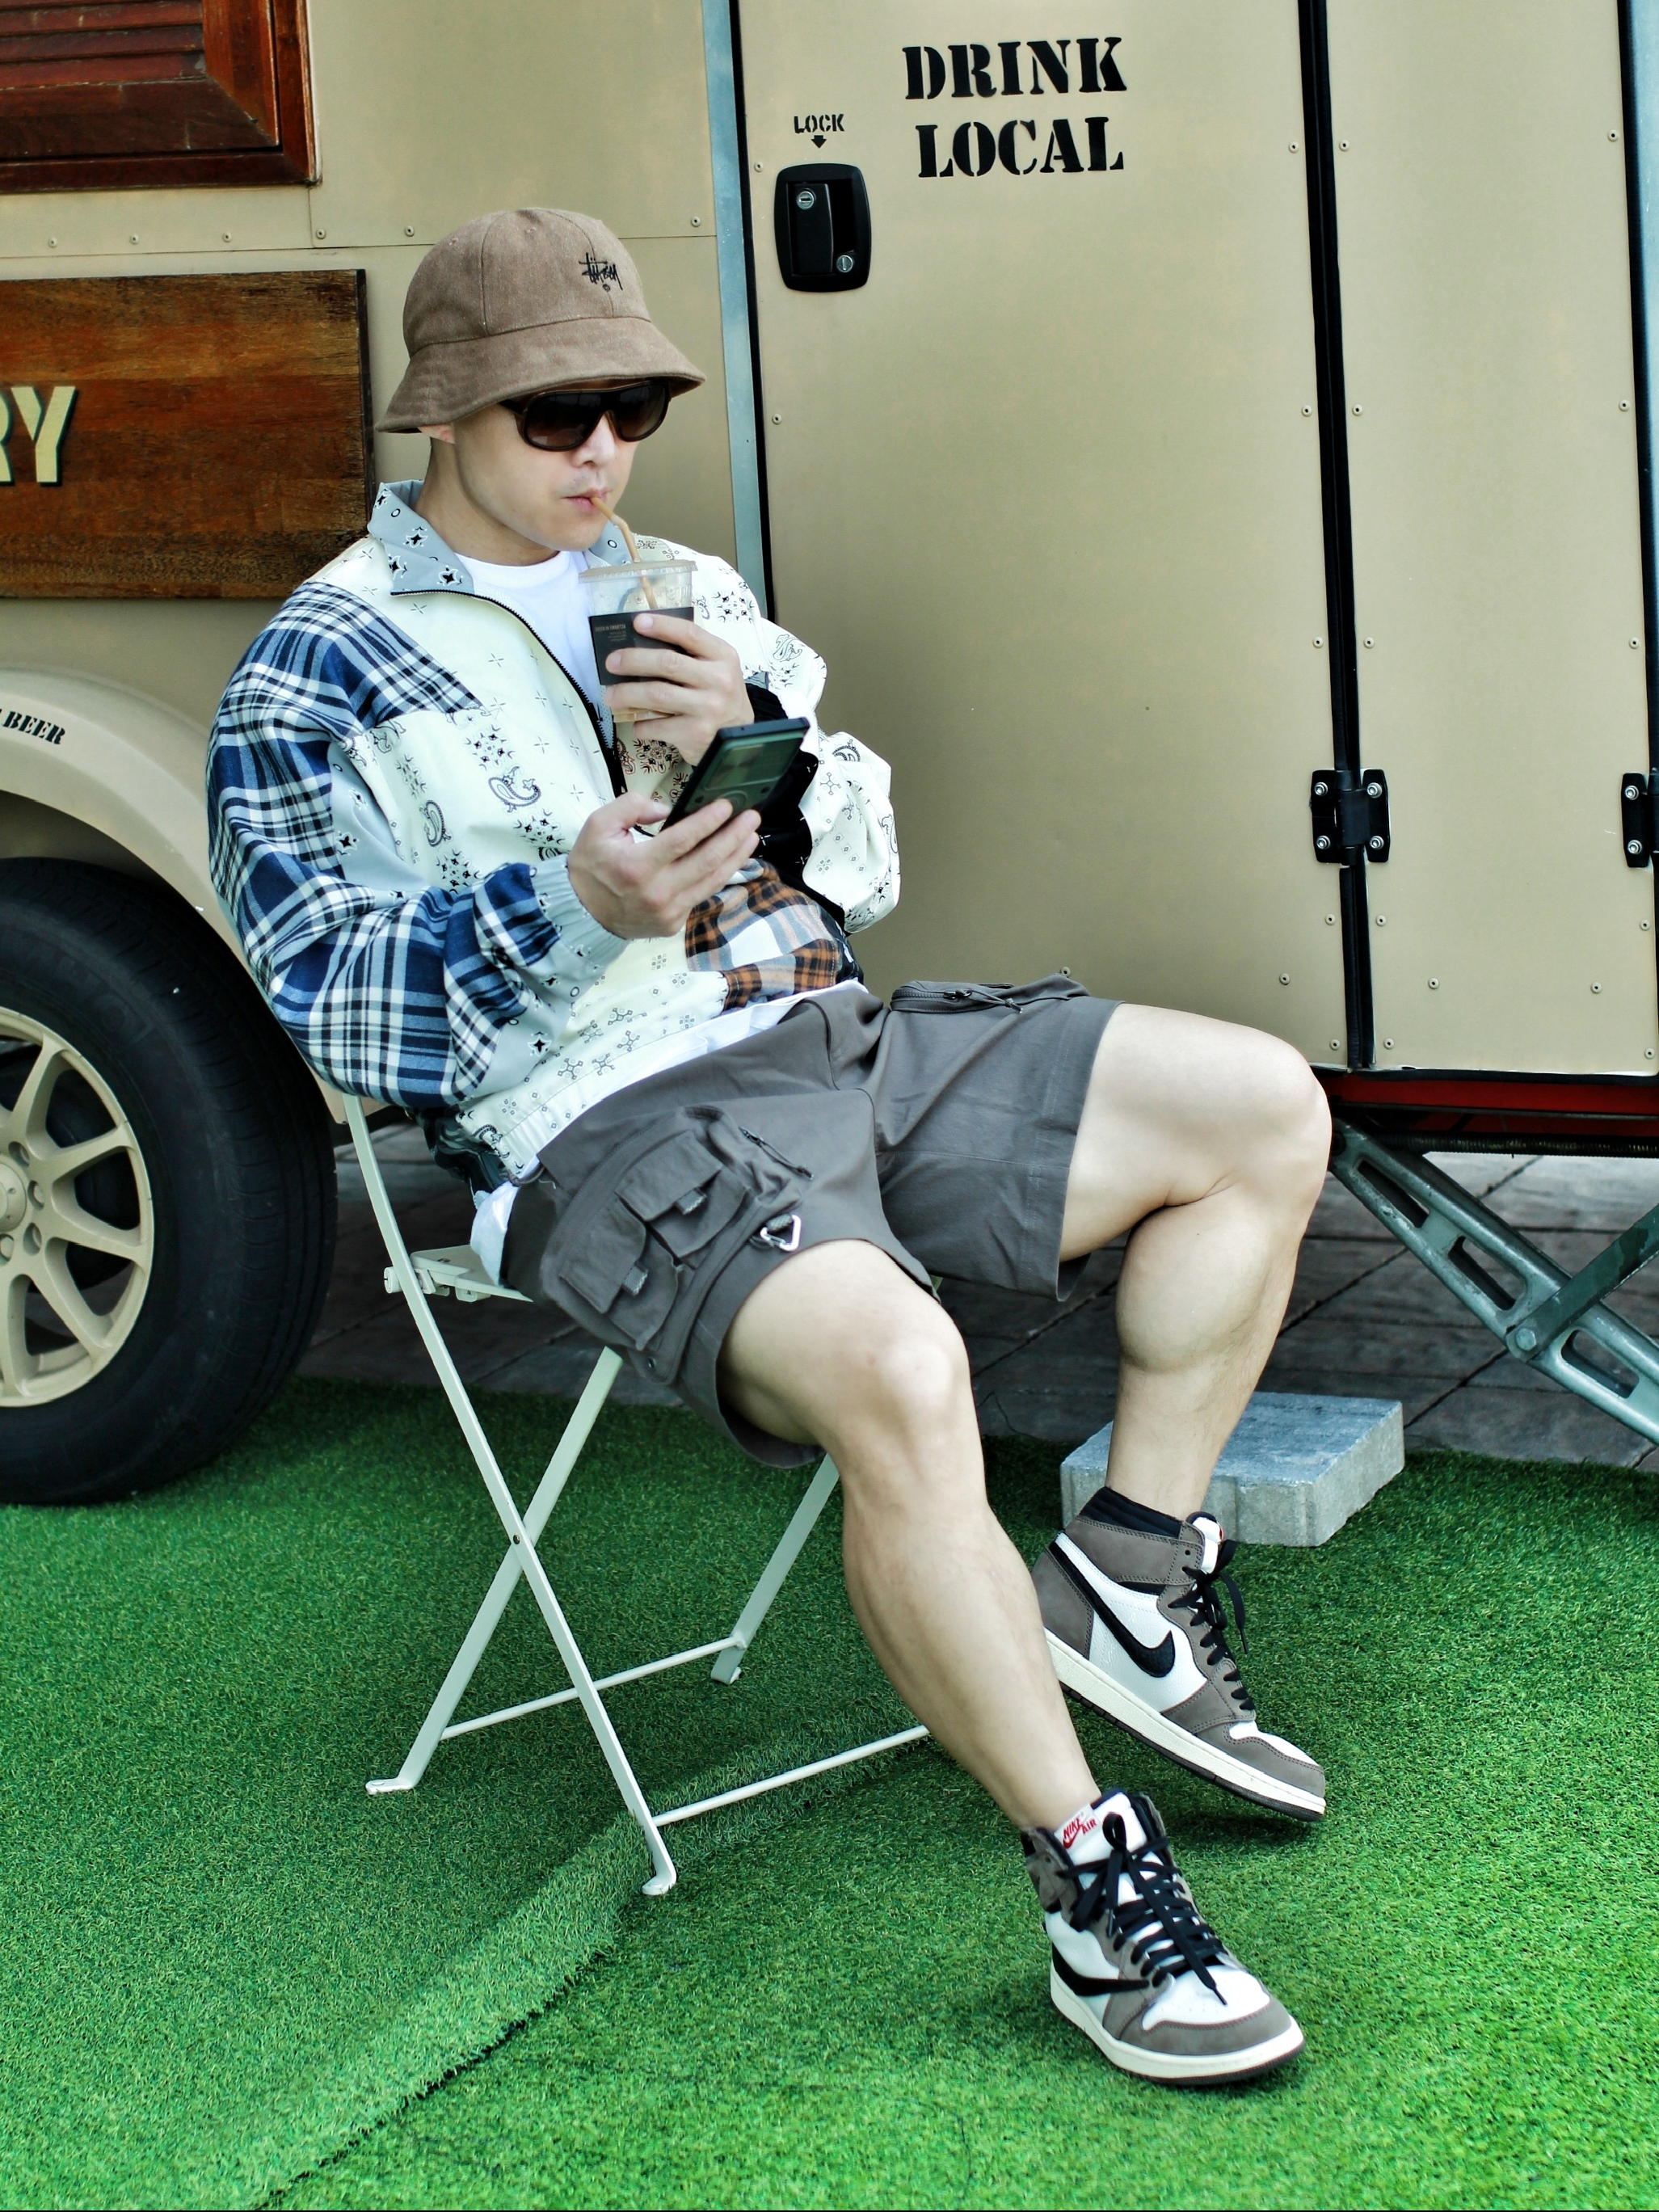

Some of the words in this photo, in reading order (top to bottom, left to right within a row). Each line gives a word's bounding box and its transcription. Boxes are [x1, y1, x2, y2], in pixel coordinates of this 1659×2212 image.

[902, 36, 1127, 99] DRINK
[794, 113, 845, 134] LOCK
[915, 116, 1124, 178] LOCAL
[2, 710, 65, 744] BEER
[1063, 1817, 1082, 1840] NIKE
[1081, 1818, 1097, 1835] AIR
